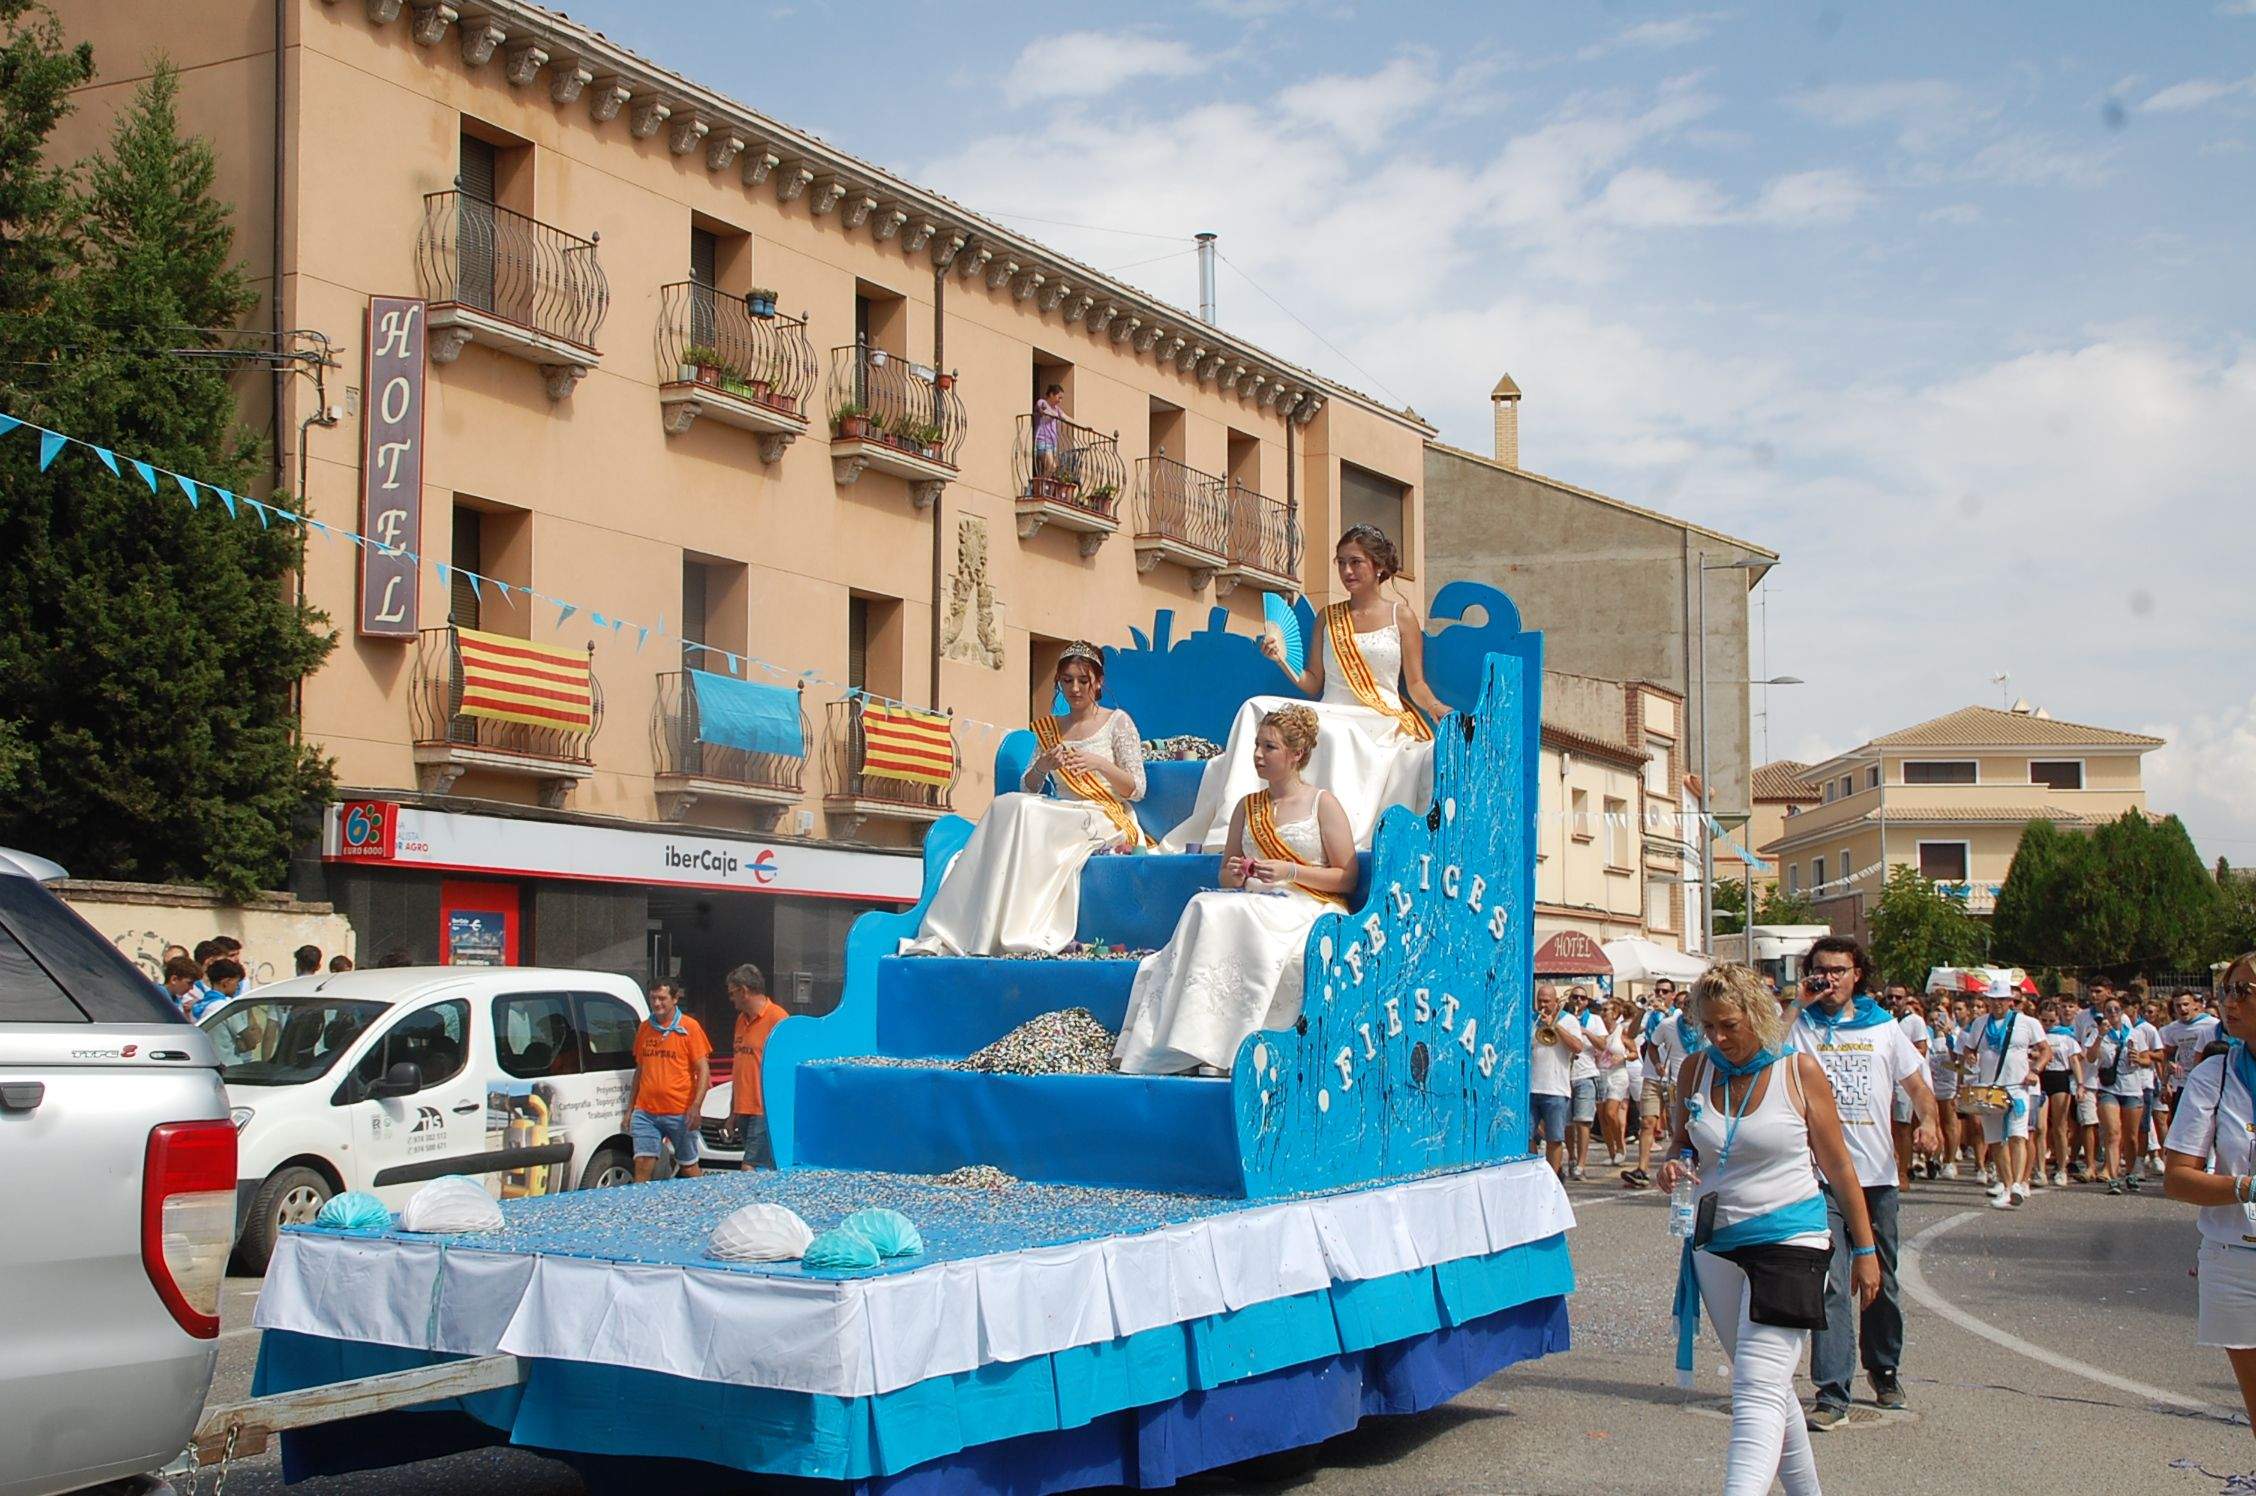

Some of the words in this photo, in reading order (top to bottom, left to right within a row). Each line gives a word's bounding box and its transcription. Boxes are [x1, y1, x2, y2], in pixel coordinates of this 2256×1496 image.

[375, 304, 419, 623] HOTEL
[343, 846, 362, 855] EURO
[363, 846, 384, 856] 6000
[405, 842, 429, 852] AGRO
[665, 845, 738, 877] iberCaja
[1344, 853, 1508, 988] FELICES
[1554, 930, 1592, 958] HOTEL
[1334, 988, 1498, 1092] FIESTAS
